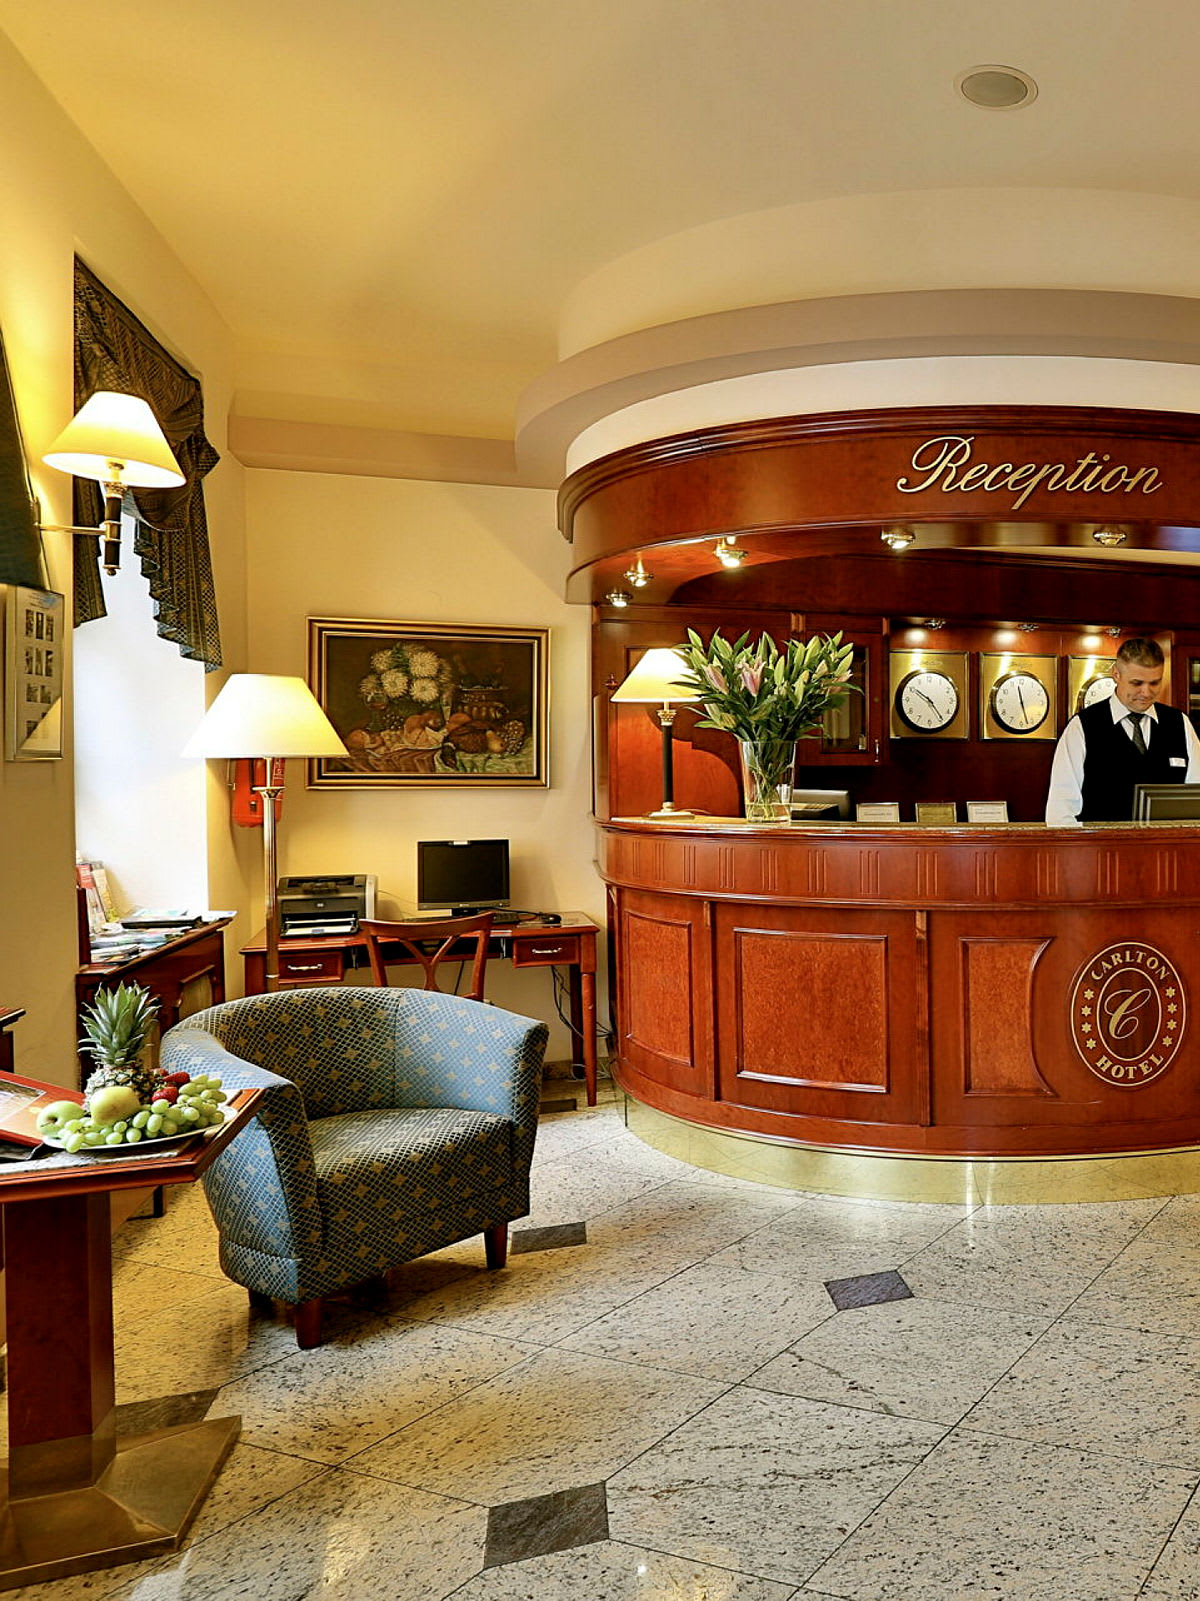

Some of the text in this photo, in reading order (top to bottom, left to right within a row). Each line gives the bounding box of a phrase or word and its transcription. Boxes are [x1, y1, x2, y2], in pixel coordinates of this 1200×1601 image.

[896, 436, 1163, 510] Reception
[1091, 950, 1171, 981] CARLTON
[1095, 1053, 1164, 1079] HOTEL
